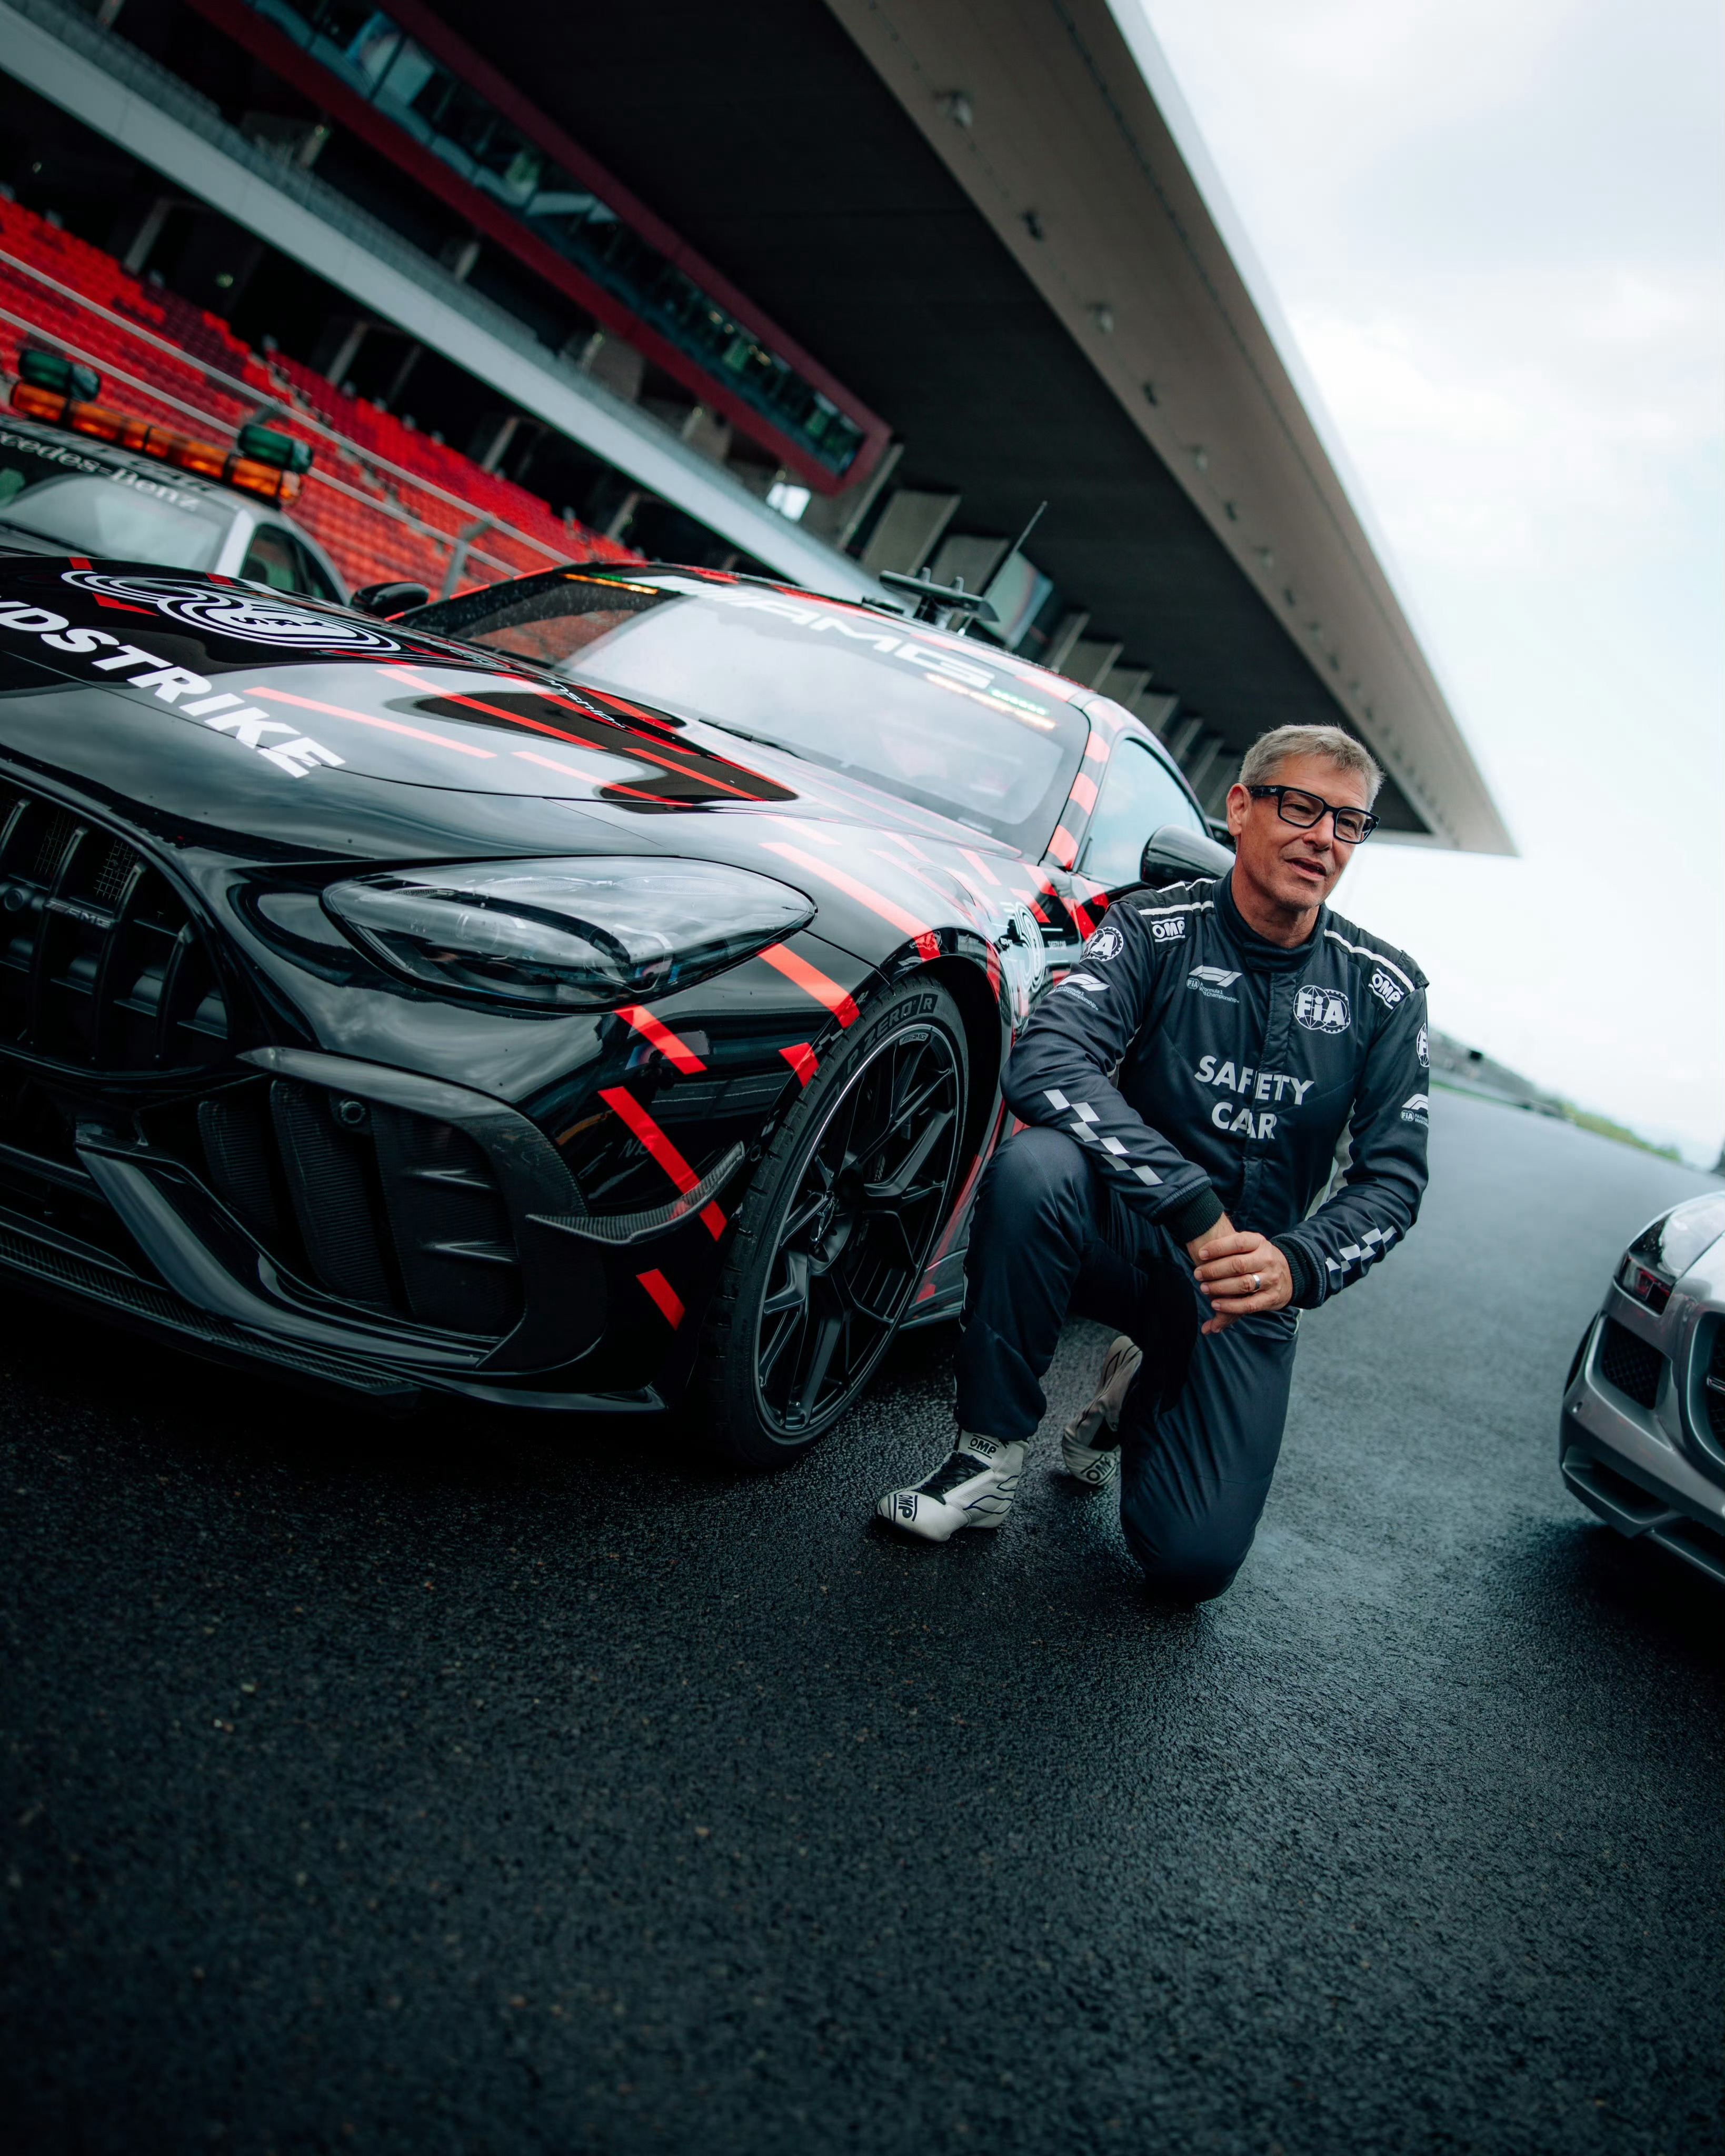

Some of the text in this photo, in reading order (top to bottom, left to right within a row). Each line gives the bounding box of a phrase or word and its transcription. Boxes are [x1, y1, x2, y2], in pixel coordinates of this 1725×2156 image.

[0, 432, 200, 512] cedes-Benz
[730, 596, 995, 690] AMG
[0, 601, 346, 778] DSTRIKE
[65, 907, 112, 930] AMG
[1152, 920, 1185, 939] OMP
[1372, 973, 1401, 1003] OMP
[847, 1049, 859, 1074] P
[923, 997, 933, 1010] R
[1194, 1055, 1315, 1105] SAFETY
[1211, 1101, 1278, 1140] CAR
[970, 1438, 997, 1455] OMP
[1086, 1456, 1112, 1482] OMP
[898, 1494, 914, 1519] OMP
